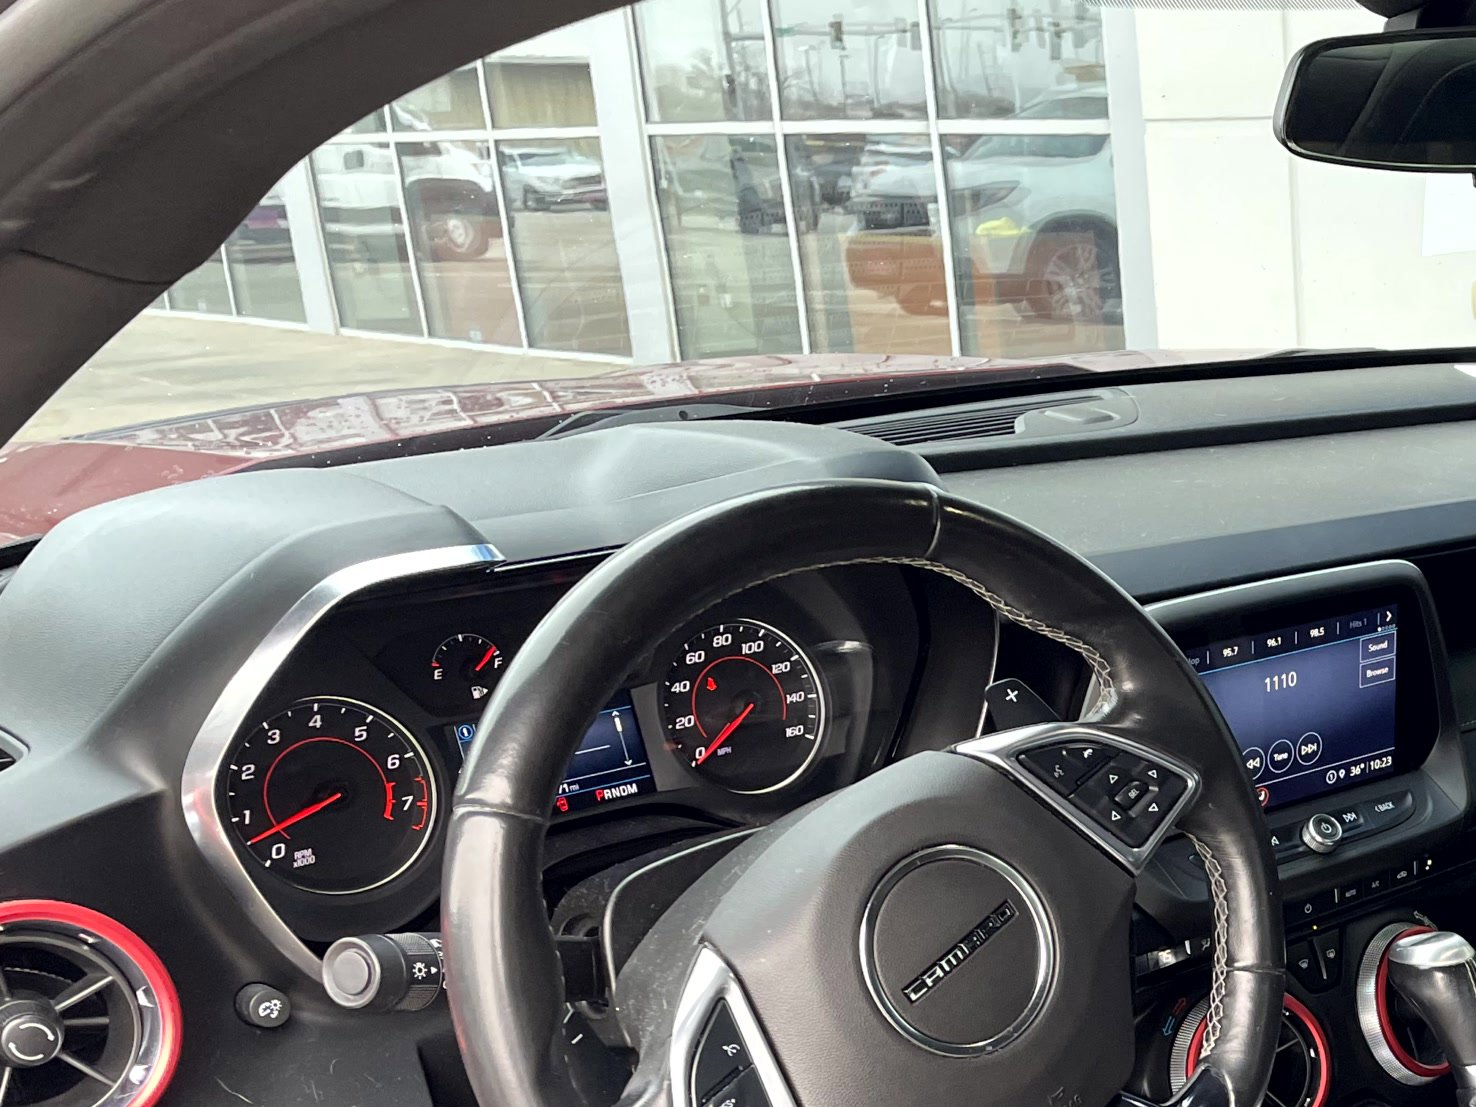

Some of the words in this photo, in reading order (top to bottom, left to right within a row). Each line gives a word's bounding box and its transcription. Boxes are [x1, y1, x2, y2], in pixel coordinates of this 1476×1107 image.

[1350, 620, 1363, 629] Hits
[1310, 627, 1325, 638] 98.5
[713, 634, 732, 647] 80
[1267, 637, 1282, 648] 96.1
[1368, 641, 1388, 652] Sound
[741, 641, 764, 655] 100
[1223, 647, 1238, 658] 95.7
[494, 657, 503, 668] F
[686, 651, 705, 664] 60
[433, 668, 443, 680] E
[771, 661, 791, 674] 120
[1366, 665, 1389, 678] Browse
[671, 680, 690, 693] 40
[1264, 671, 1297, 692] 1110
[786, 692, 804, 704] 140
[308, 715, 322, 728] 4
[675, 715, 694, 730] 20
[267, 729, 280, 744] 3
[354, 726, 367, 741] 5
[785, 725, 804, 738] 160
[695, 747, 705, 759] 0
[717, 746, 732, 757] MPH
[1274, 752, 1288, 761] Tune
[387, 754, 400, 769] 6
[1370, 756, 1392, 771] 10:23
[241, 764, 255, 780] 2
[570, 783, 580, 793] mi
[595, 783, 638, 801] PRNDM
[401, 795, 414, 811] 7
[1379, 801, 1395, 812] BACK
[243, 810, 250, 824] 1
[271, 843, 286, 858] 0
[294, 848, 312, 860] RPM
[293, 855, 316, 868] x1000
[905, 904, 1013, 1002] CAMARO
